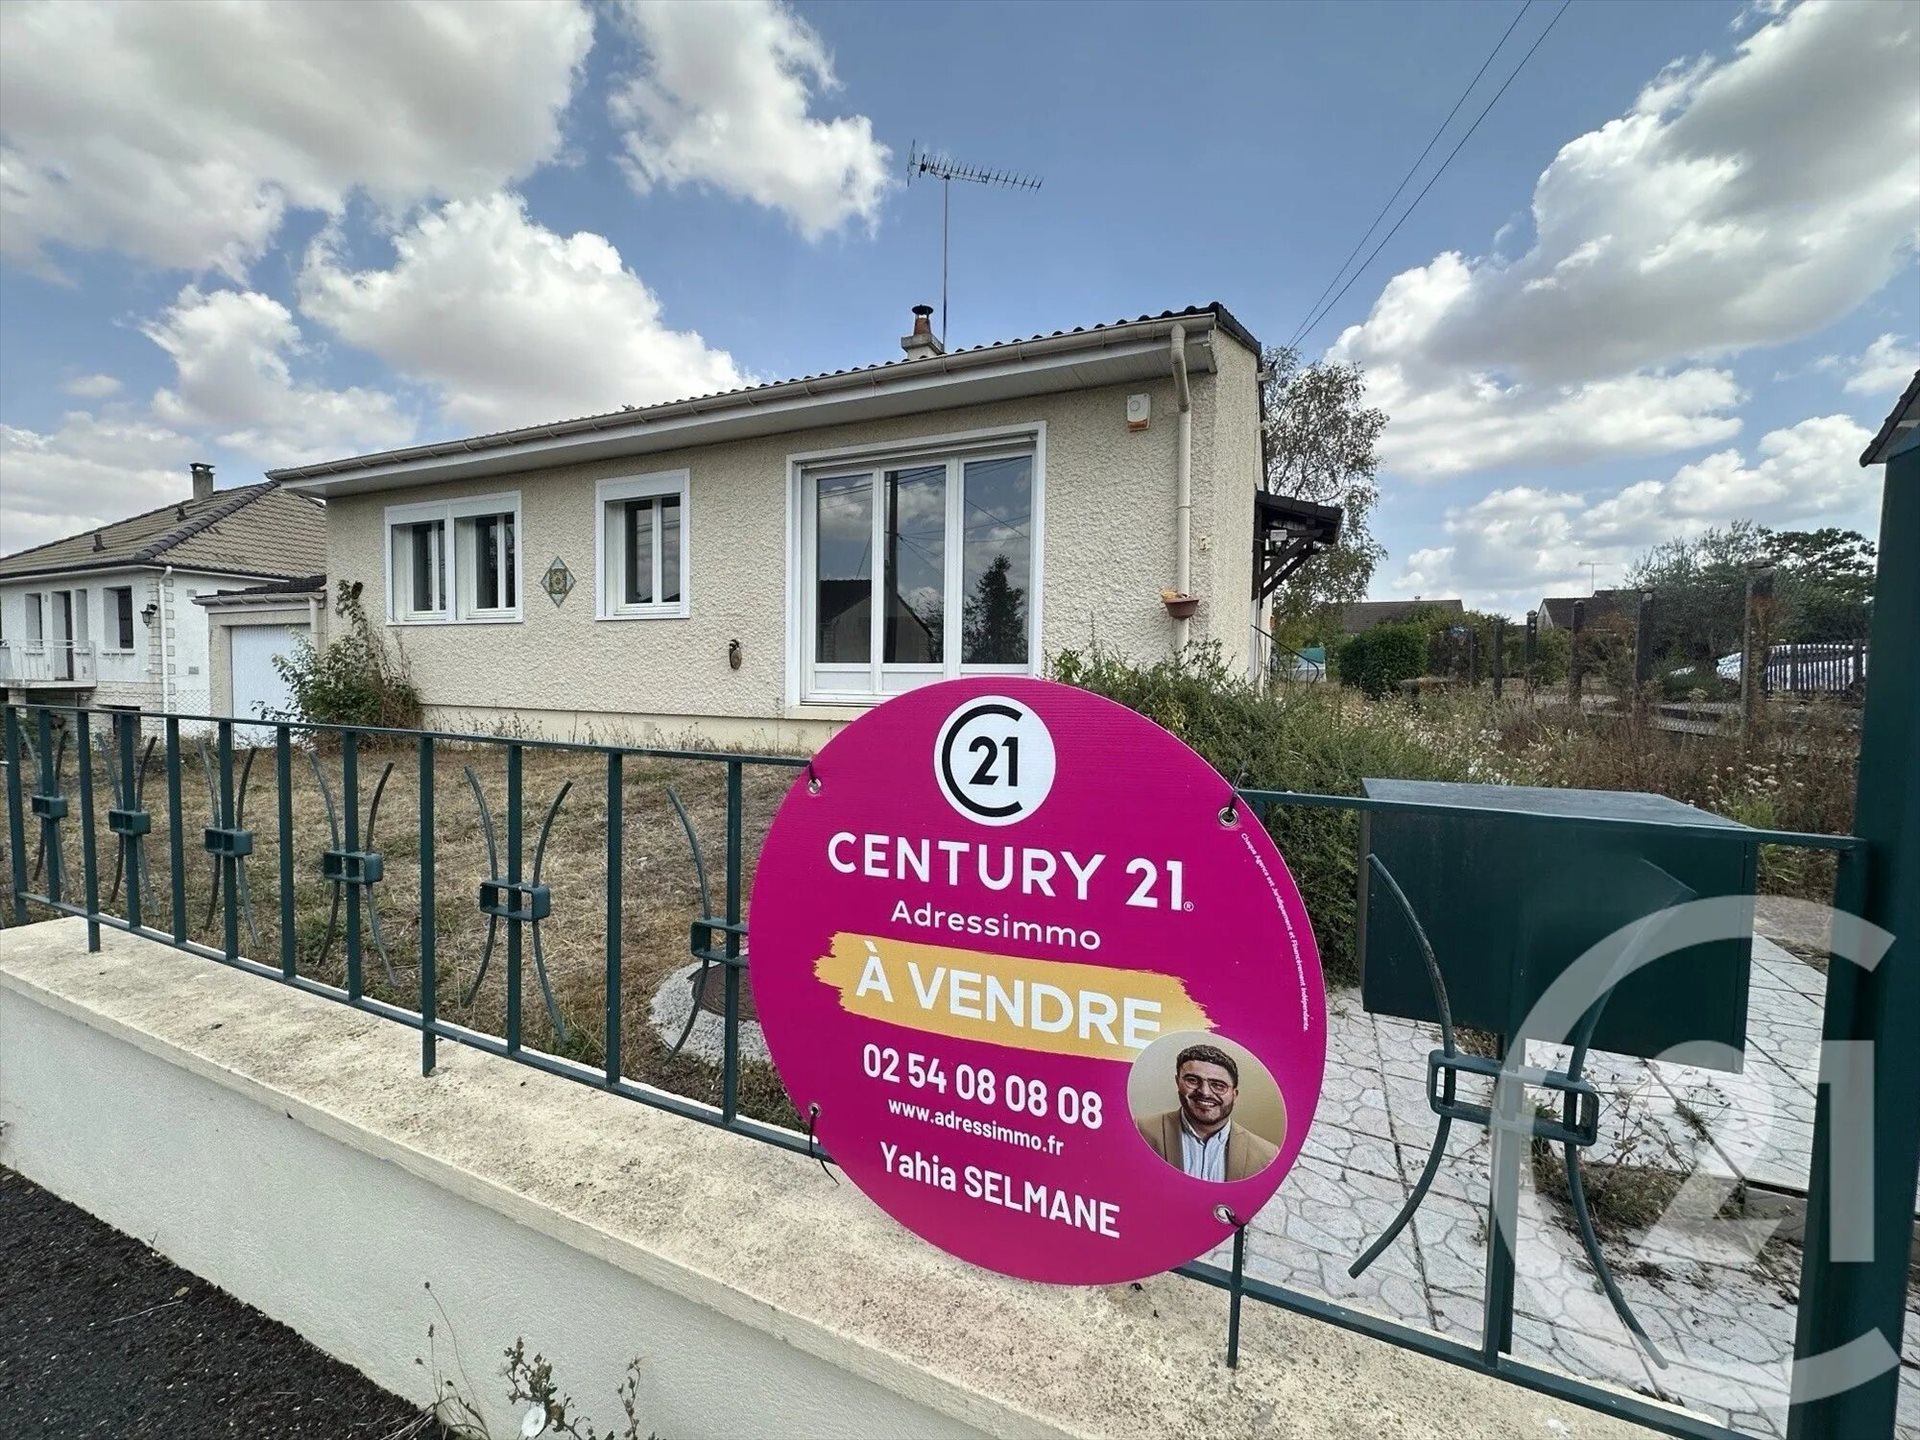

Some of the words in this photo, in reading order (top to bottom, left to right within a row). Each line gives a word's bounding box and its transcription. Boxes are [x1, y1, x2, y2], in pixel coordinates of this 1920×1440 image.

[827, 831, 1106, 901] CENTURY
[1240, 832, 1258, 855] Chaque
[1254, 855, 1270, 877] Agence
[1266, 876, 1276, 888] est
[1271, 887, 1293, 931] Juridiquement
[891, 900, 1101, 950] Adressimmo
[855, 940, 894, 1003] À
[907, 961, 1163, 1051] VENDRE
[863, 1043, 900, 1084] 02
[908, 1052, 947, 1094] 54
[955, 1064, 996, 1105] 08
[1005, 1074, 1048, 1117] 08
[1057, 1086, 1103, 1130] 08
[888, 1099, 1064, 1156] www.adressimmo.fr
[880, 1141, 957, 1192] Yahia
[964, 1165, 1120, 1239] SELMANE
